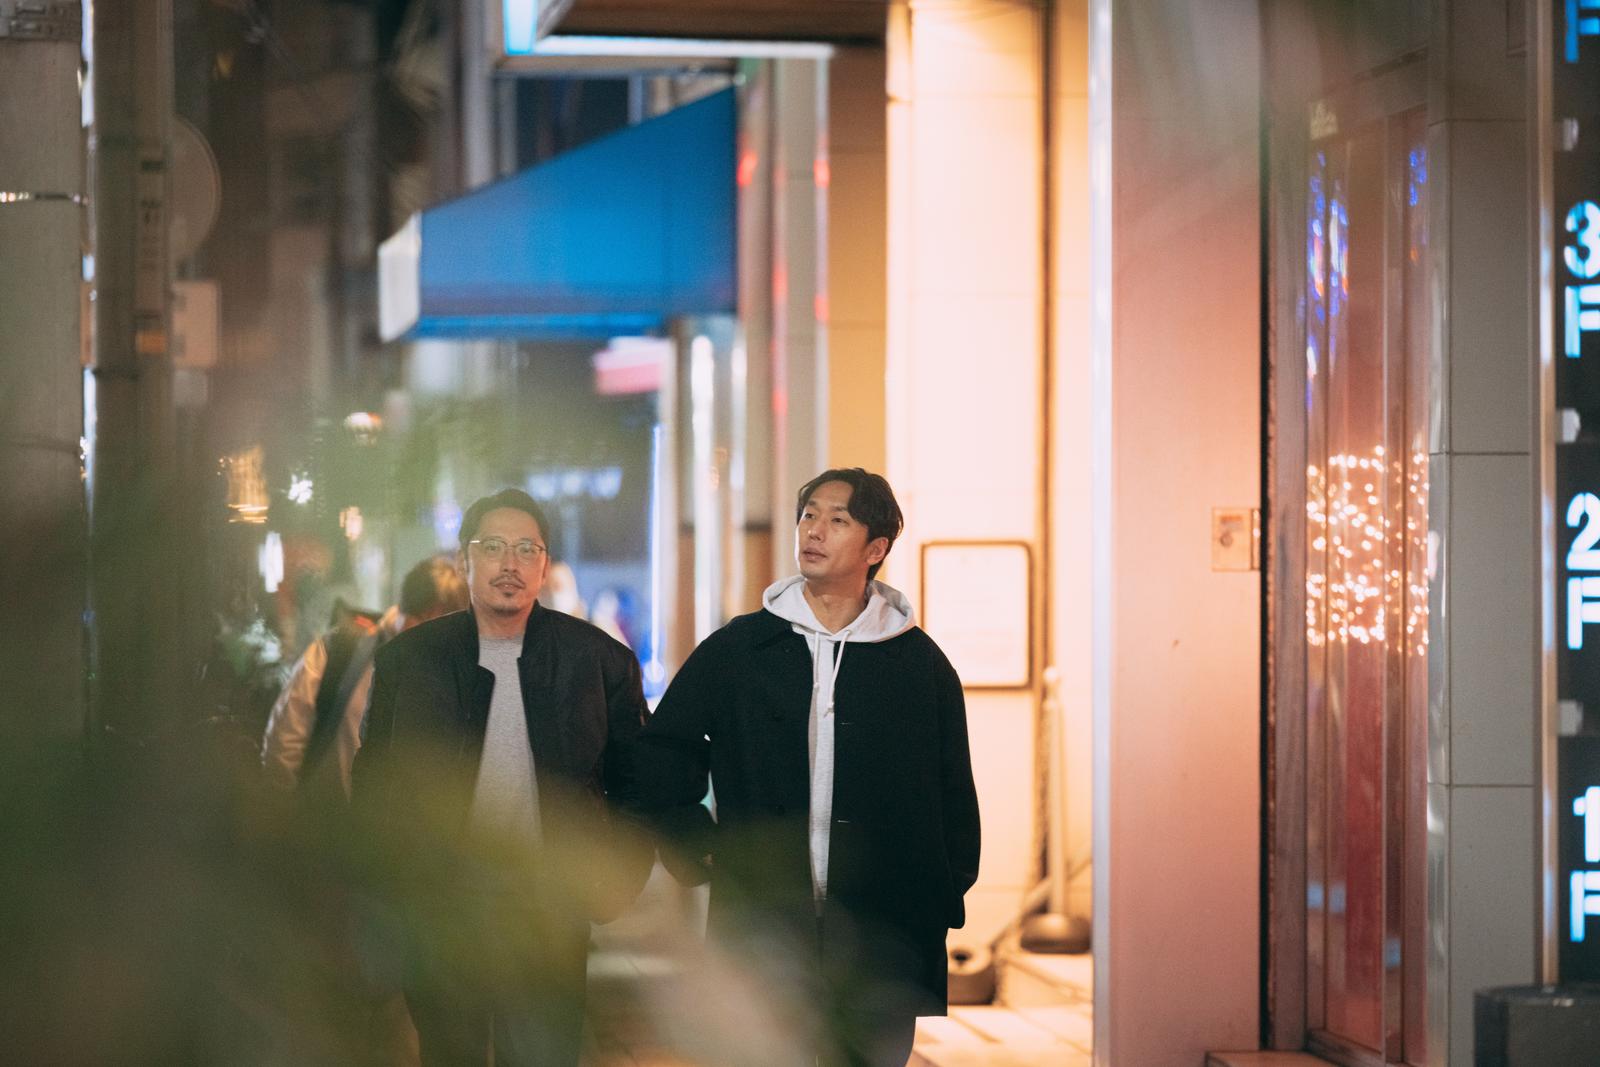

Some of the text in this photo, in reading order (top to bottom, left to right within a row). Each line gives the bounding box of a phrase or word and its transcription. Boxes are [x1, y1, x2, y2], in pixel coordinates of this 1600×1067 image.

[1564, 200, 1600, 358] 3F
[1566, 492, 1600, 649] 2F
[1570, 786, 1600, 942] 1F
